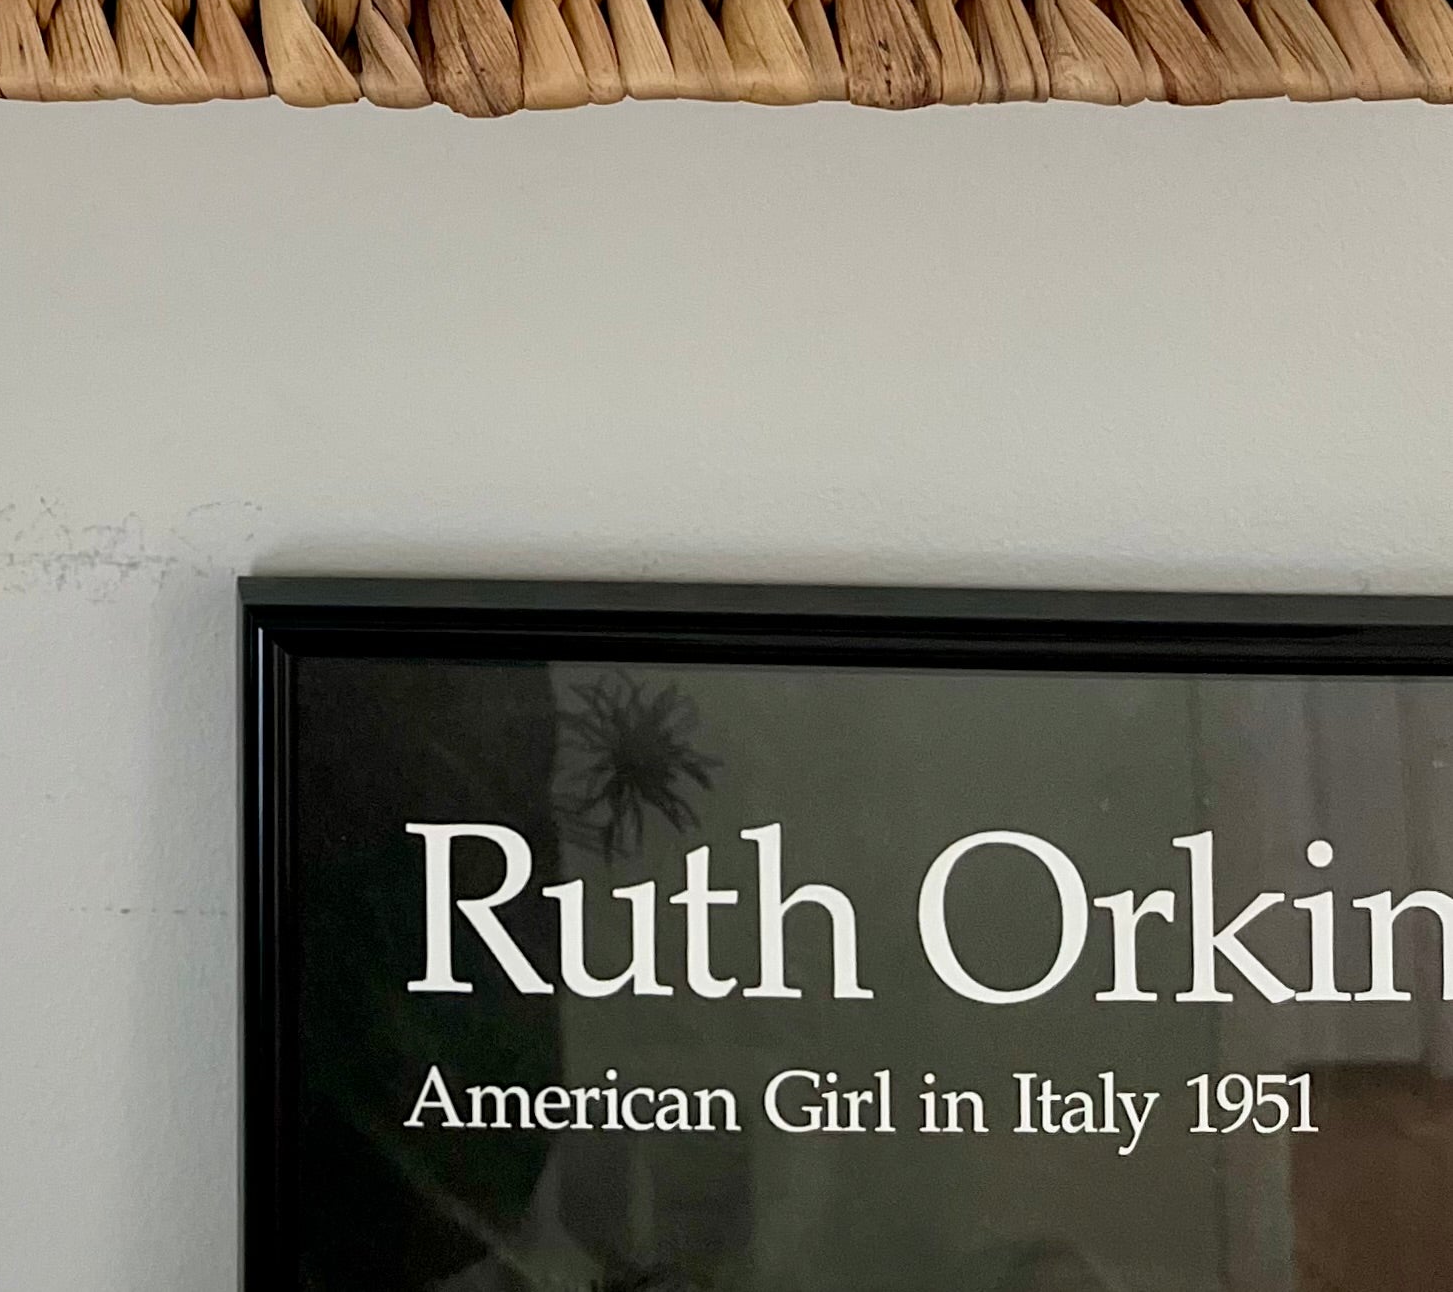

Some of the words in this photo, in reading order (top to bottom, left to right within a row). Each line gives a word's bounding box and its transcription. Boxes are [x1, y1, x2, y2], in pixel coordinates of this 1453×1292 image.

[404, 820, 875, 999] Ruth
[917, 828, 1453, 1006] Orkin
[403, 1063, 742, 1133] American
[763, 1068, 897, 1135] Girl
[919, 1071, 989, 1135] in
[1013, 1071, 1160, 1156] Italy
[1186, 1073, 1320, 1135] 1951
